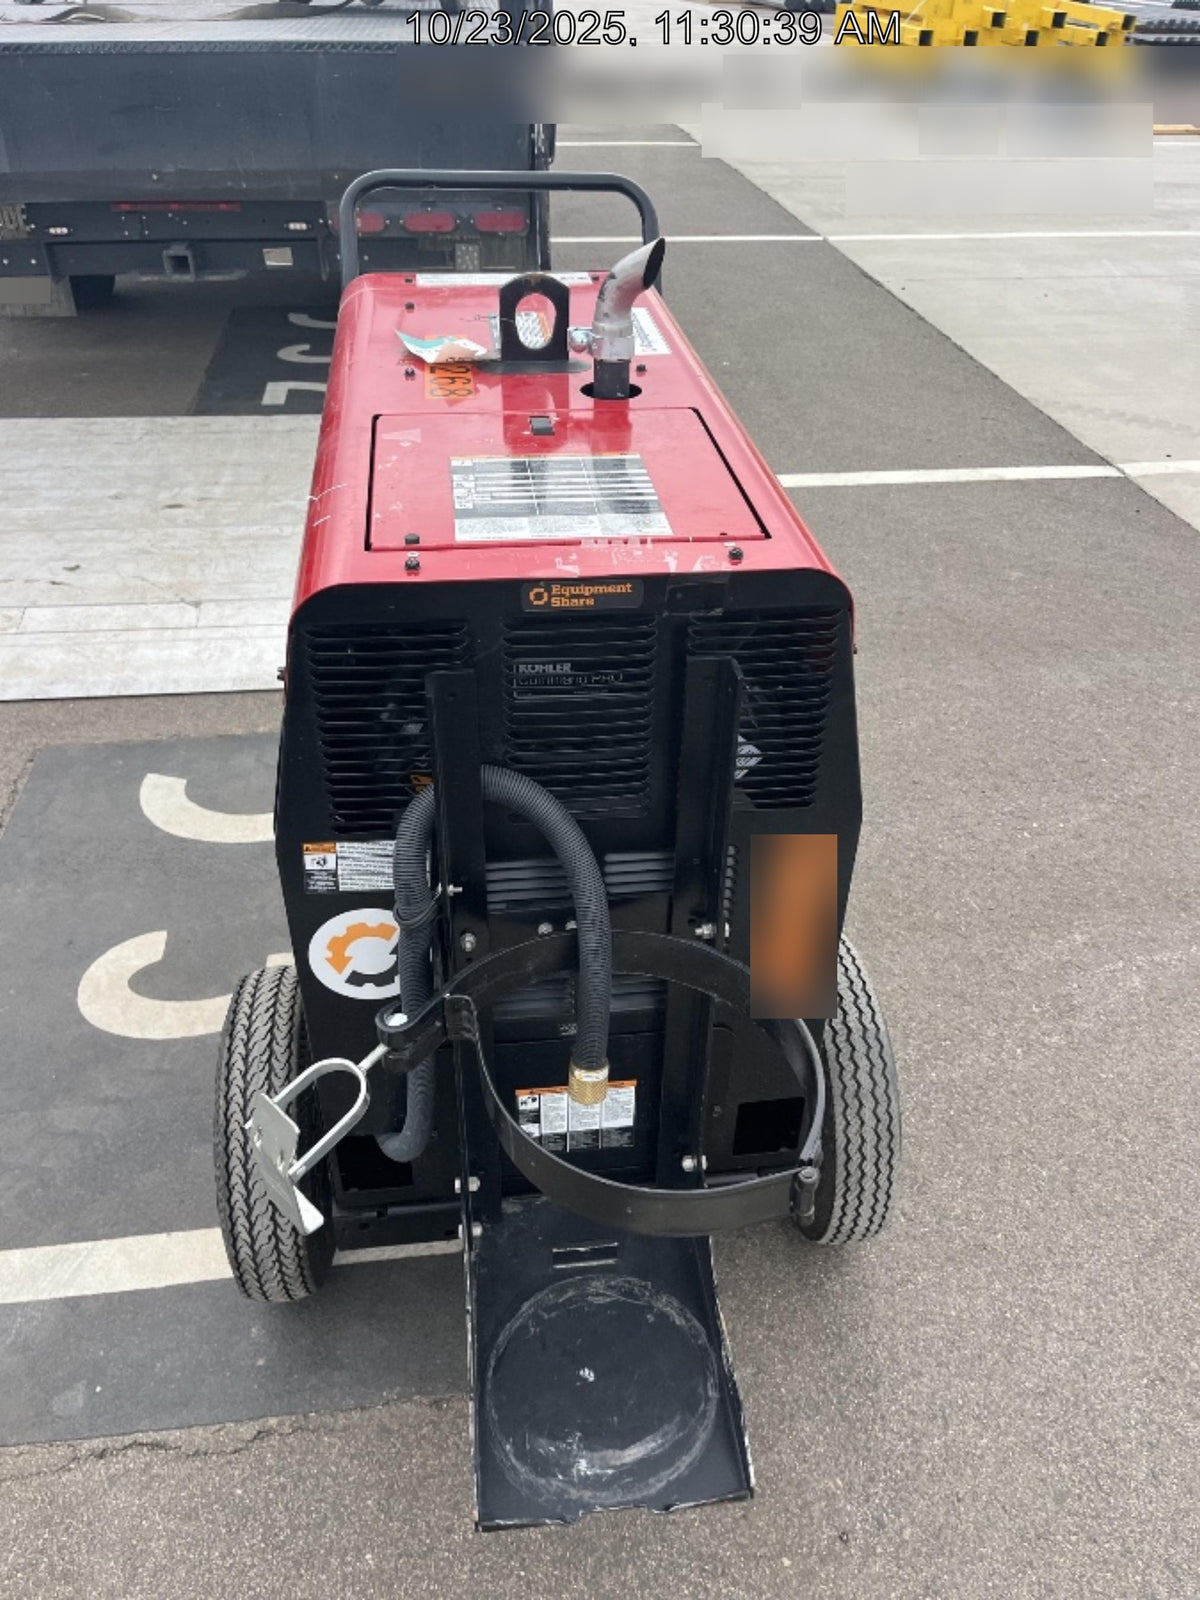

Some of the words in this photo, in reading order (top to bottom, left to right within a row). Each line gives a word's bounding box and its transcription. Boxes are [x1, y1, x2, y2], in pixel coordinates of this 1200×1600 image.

[551, 582, 633, 597] Equipment
[551, 596, 595, 608] Share
[518, 663, 572, 673] KOHLER
